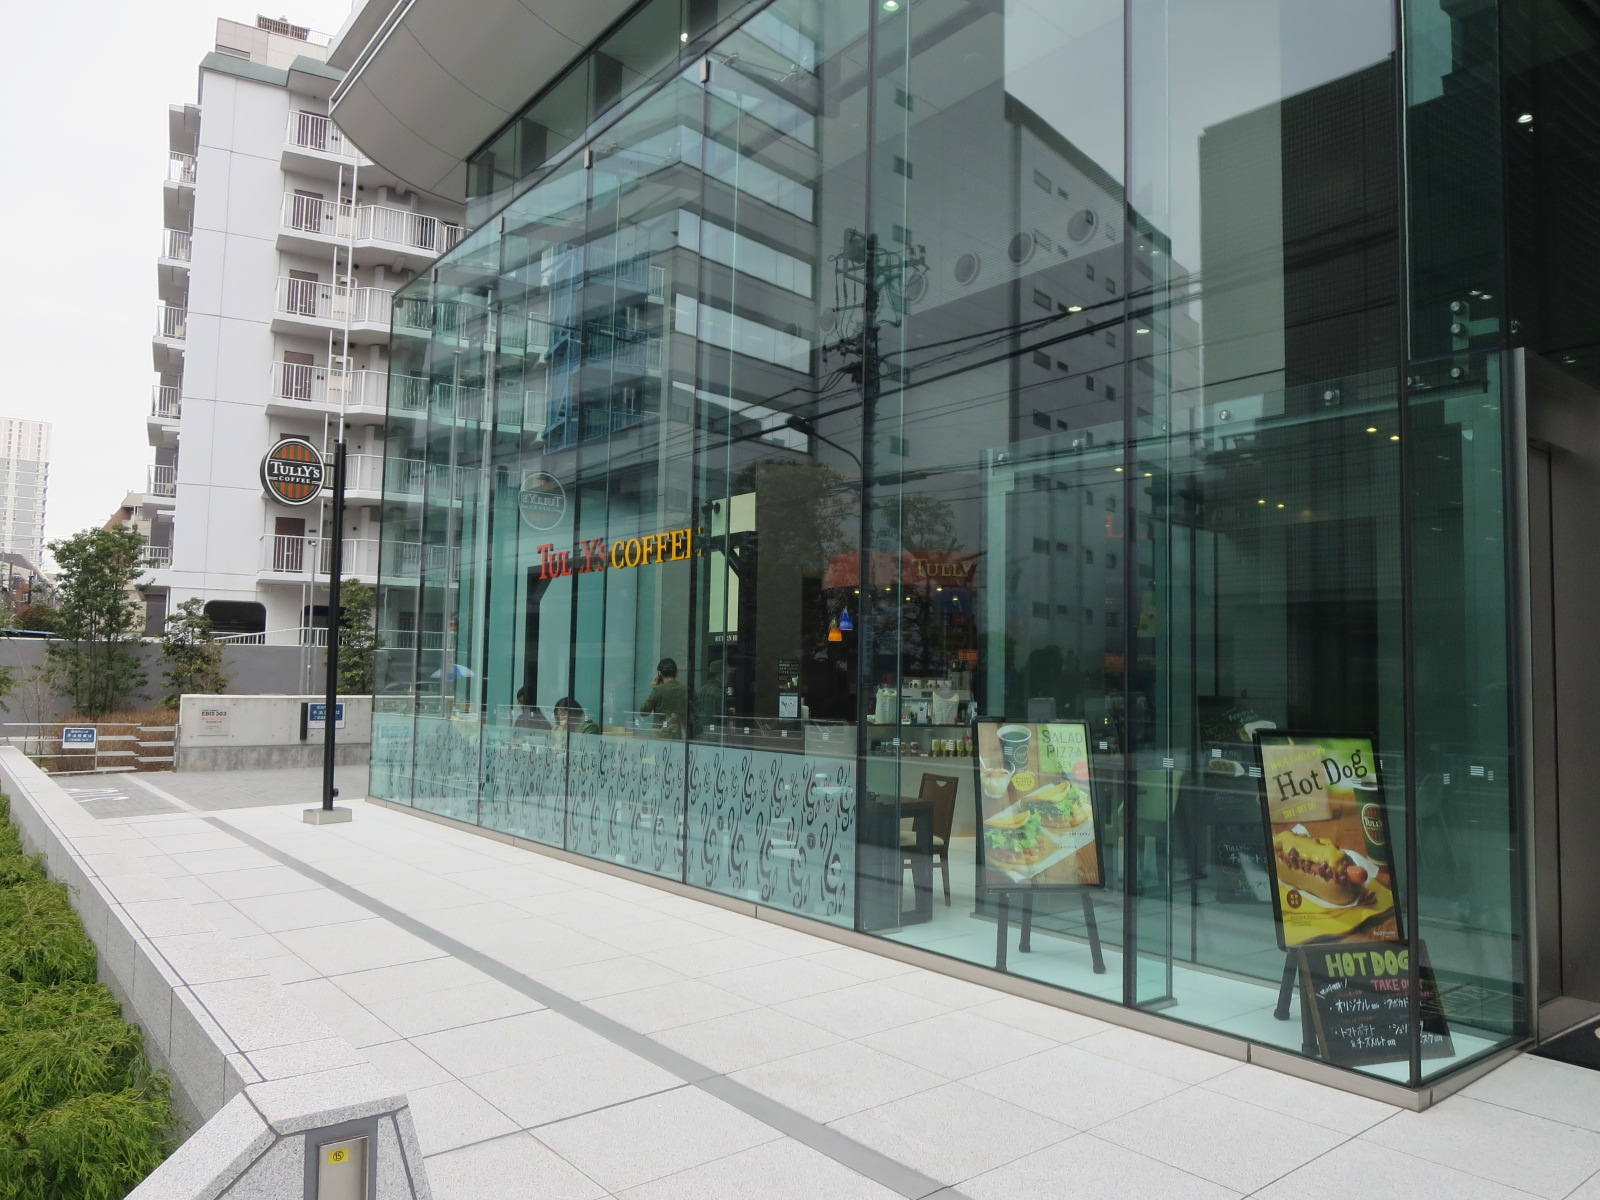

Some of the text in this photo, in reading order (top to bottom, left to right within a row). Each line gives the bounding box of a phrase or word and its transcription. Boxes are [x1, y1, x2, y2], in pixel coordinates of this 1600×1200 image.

[270, 461, 320, 478] TULLY'S
[279, 476, 311, 484] COFFEE
[537, 537, 606, 580] TULY'S
[1041, 729, 1083, 744] SALAD
[1047, 744, 1083, 759] PIZZA
[1272, 749, 1368, 802] Hot Dog
[1324, 952, 1367, 978] HOT
[1371, 978, 1400, 991] TAKE
